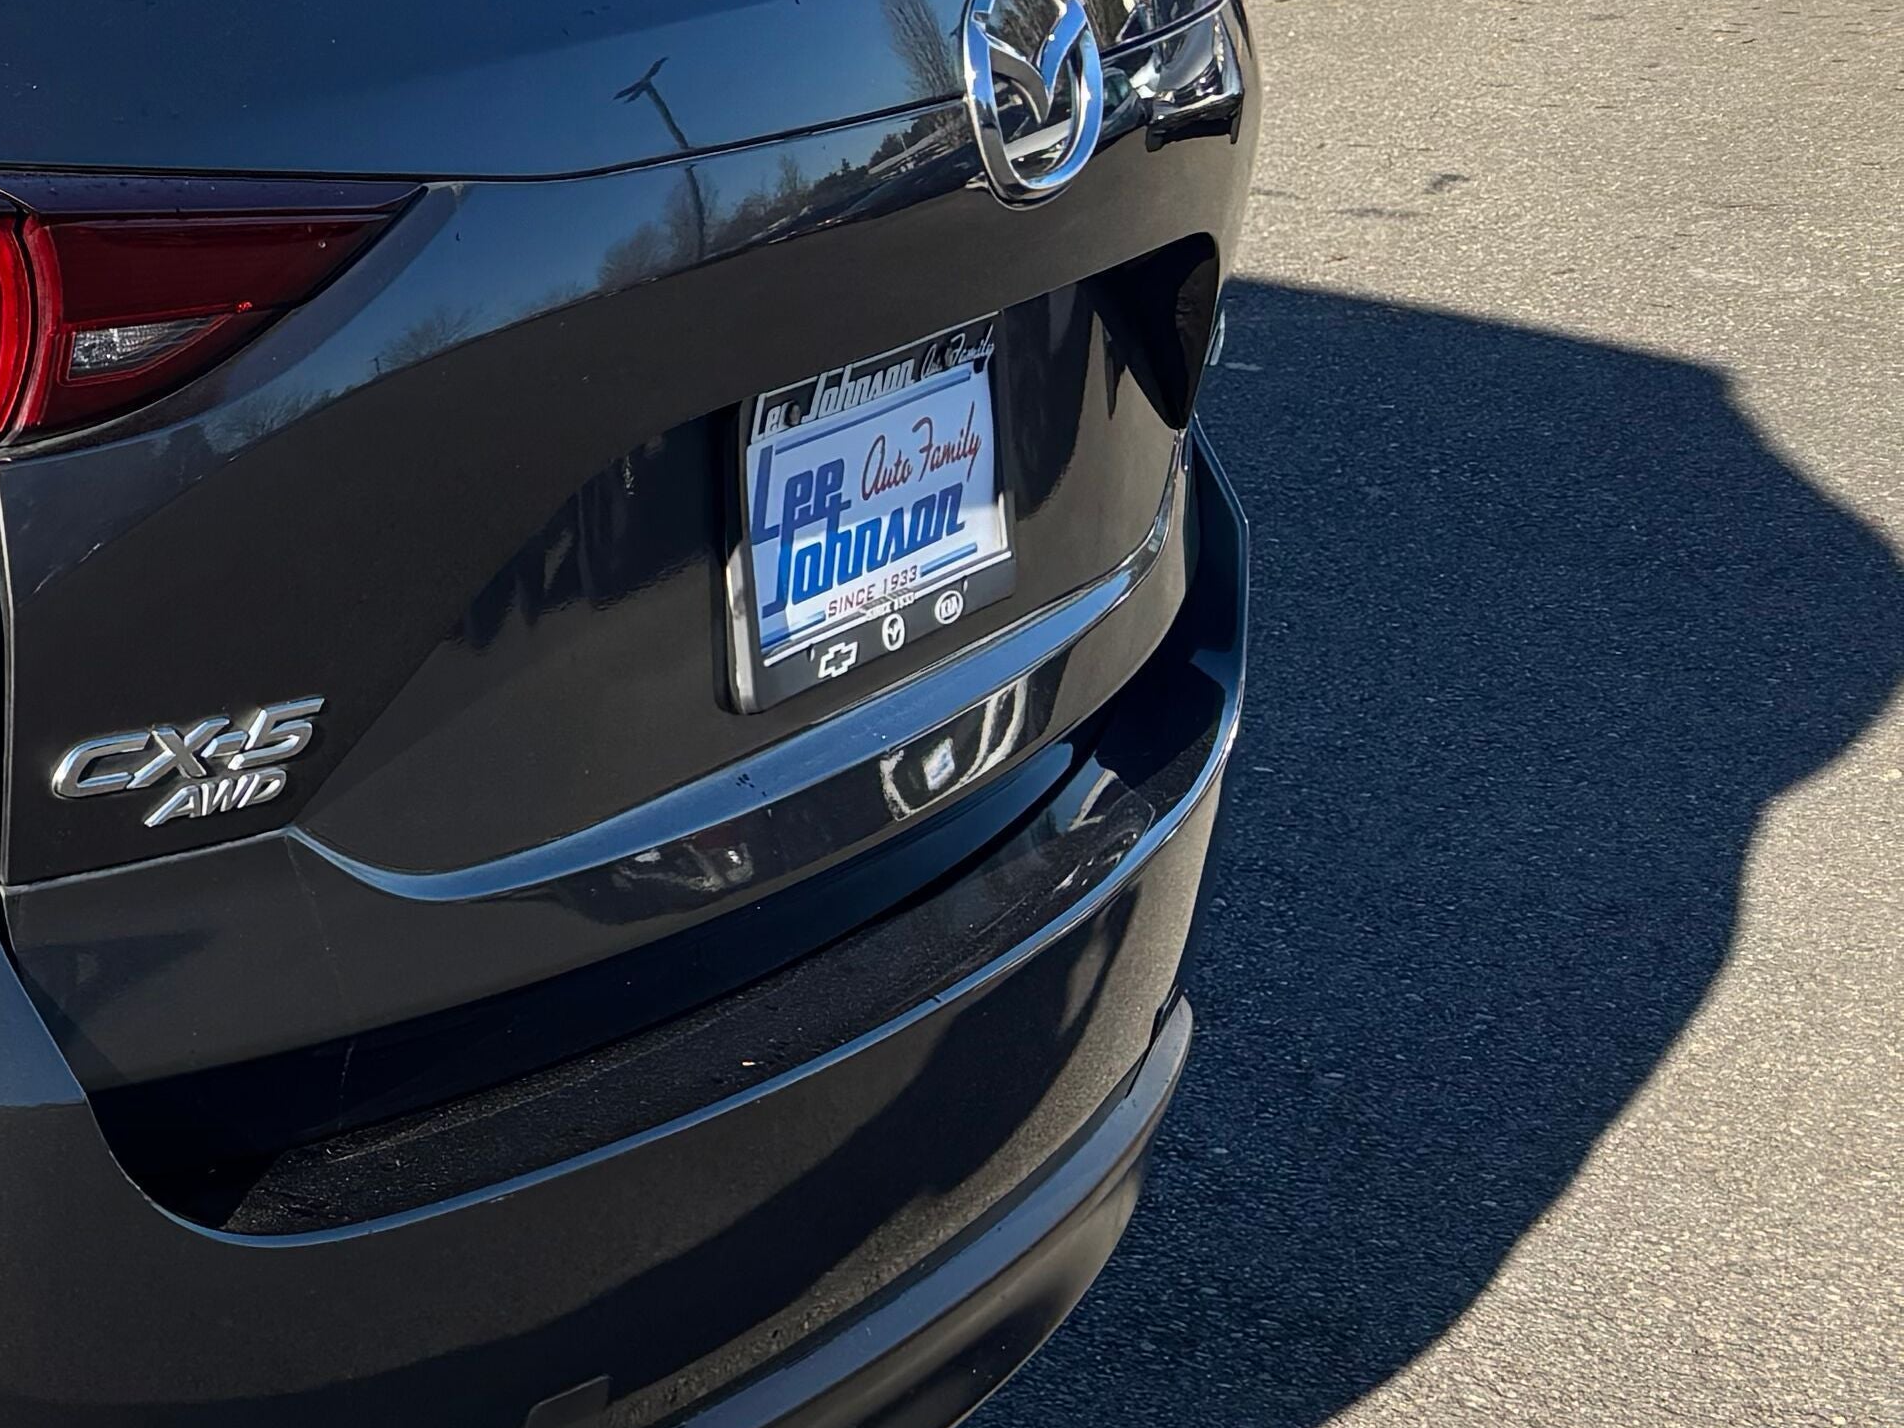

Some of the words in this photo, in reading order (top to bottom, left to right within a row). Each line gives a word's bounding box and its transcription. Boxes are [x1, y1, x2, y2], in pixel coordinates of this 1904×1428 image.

[801, 359, 917, 423] Johnson
[752, 445, 852, 545] Lee
[861, 434, 913, 501] Auto
[912, 401, 982, 483] Family
[761, 481, 966, 619] Johnson
[828, 583, 876, 618] SINCE
[883, 565, 918, 595] 1933
[51, 695, 325, 799] CX-5
[144, 767, 287, 827] AWD
